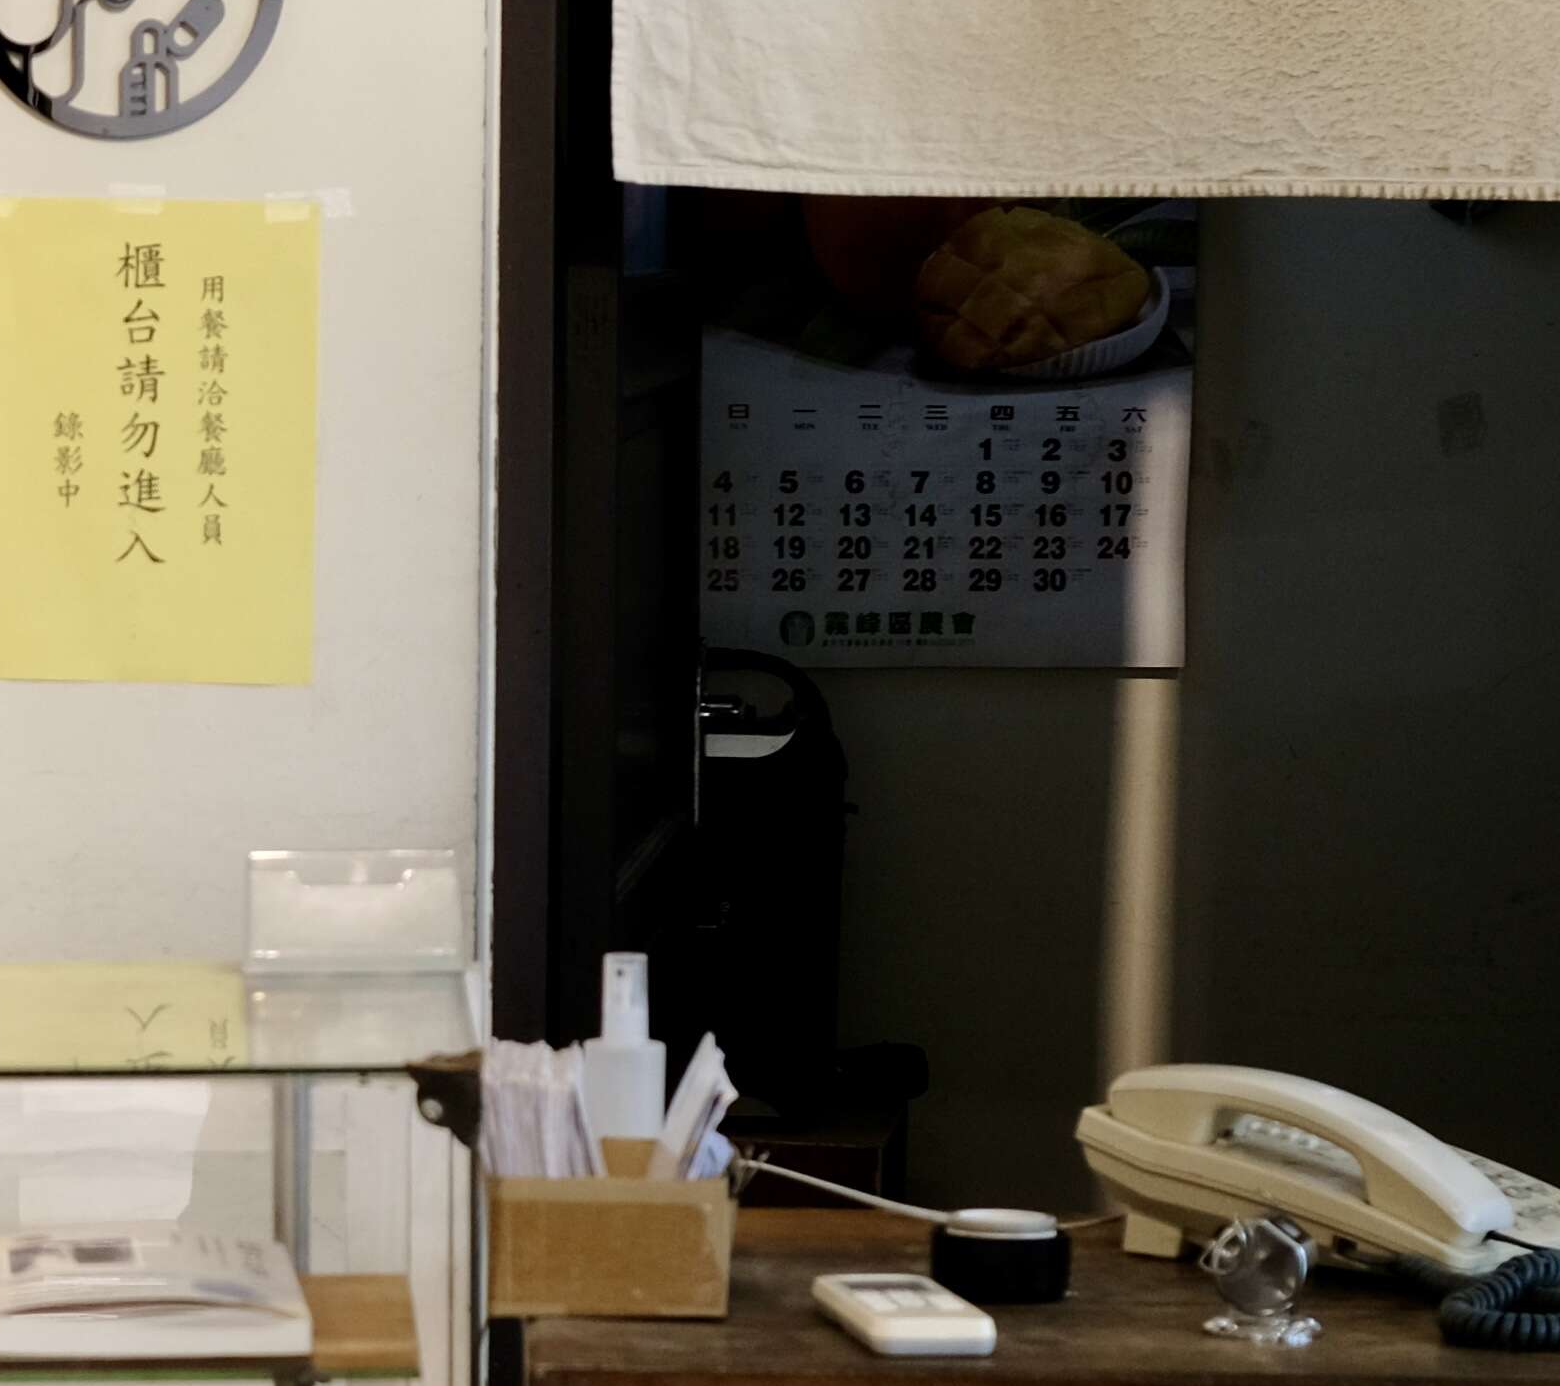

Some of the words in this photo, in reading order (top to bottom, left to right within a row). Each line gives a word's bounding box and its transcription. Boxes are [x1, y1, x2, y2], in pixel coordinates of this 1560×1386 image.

[115, 241, 167, 564] 櫃台請勿進入
[197, 275, 229, 546] 用餐請洽餐廳人員
[729, 405, 748, 419] 日
[859, 405, 882, 419] 二
[925, 405, 948, 419] 三
[991, 406, 1014, 420] 四
[1056, 407, 1079, 421] 五
[1121, 407, 1146, 422] 六
[52, 411, 84, 508] 錄影中
[979, 439, 992, 460] 1
[1042, 439, 1060, 460] 2
[1108, 439, 1126, 461] 3
[714, 471, 732, 493] 4
[780, 471, 798, 493] 5
[845, 471, 864, 493] 6
[911, 472, 929, 493] 7
[976, 472, 995, 493] 8
[1041, 472, 1060, 493] 9
[1102, 472, 1132, 493] 10
[709, 505, 735, 525] 11
[774, 505, 805, 525] 12
[841, 505, 871, 526] 13
[905, 505, 937, 525] 14
[971, 505, 1001, 526] 15
[1036, 505, 1066, 526] 16
[1101, 505, 1130, 526] 17
[709, 537, 739, 559] 18
[775, 537, 805, 558] 19
[838, 537, 871, 558] 20
[904, 537, 934, 558] 21
[969, 537, 1002, 558] 22
[1034, 537, 1066, 559] 23
[1098, 537, 1130, 558] 24
[707, 569, 738, 591] 25
[772, 569, 805, 591] 26
[838, 569, 871, 591] 27
[904, 569, 936, 591] 28
[969, 569, 1001, 591] 29
[1034, 569, 1066, 591] 30
[823, 612, 976, 635] 霧峰區農會
